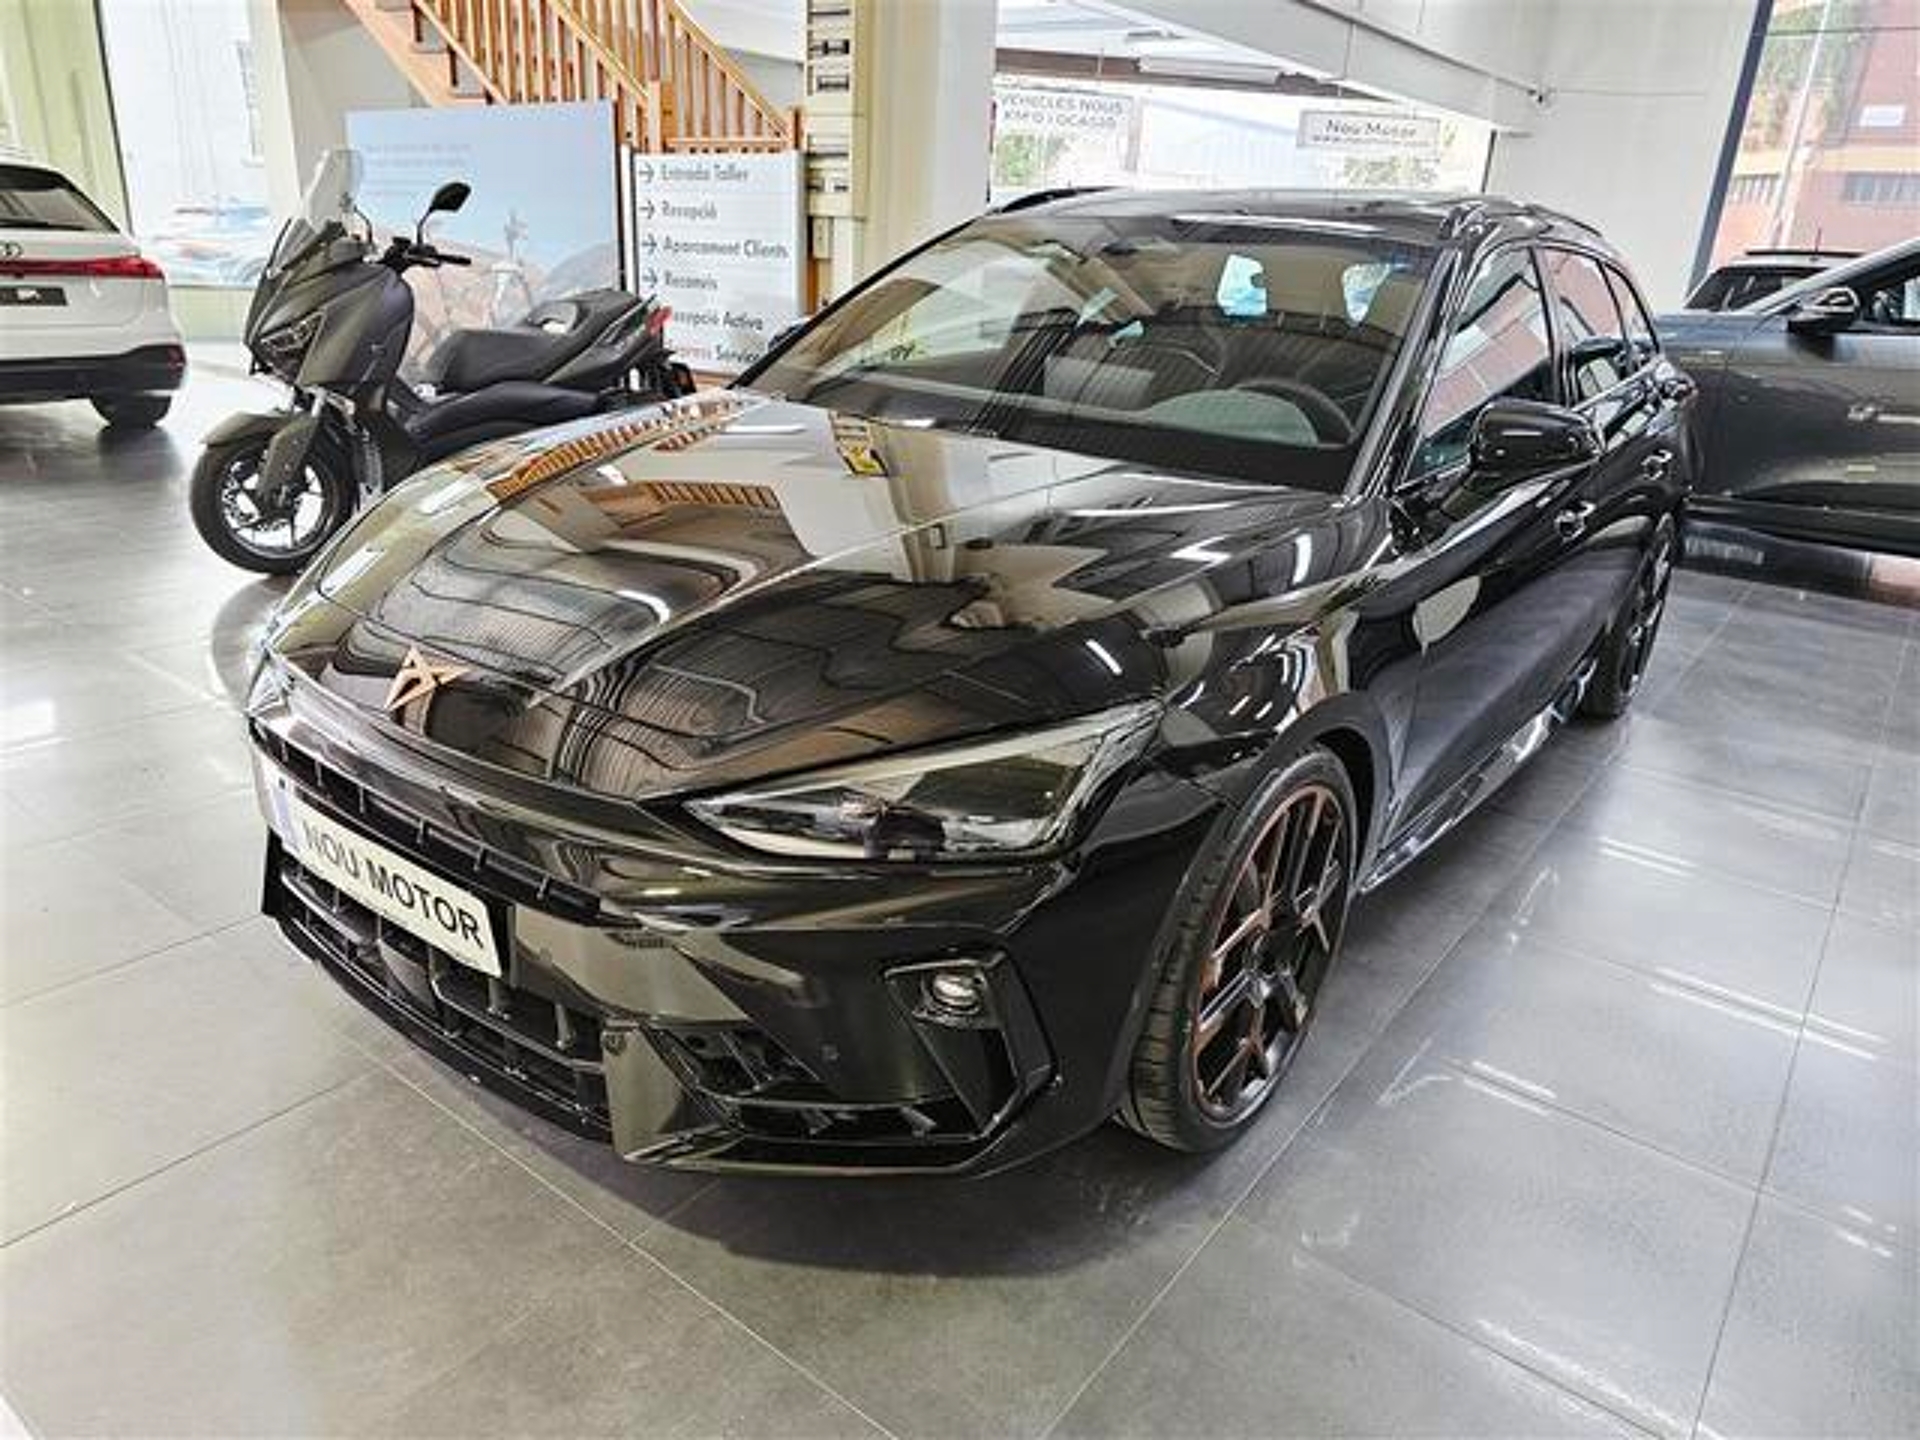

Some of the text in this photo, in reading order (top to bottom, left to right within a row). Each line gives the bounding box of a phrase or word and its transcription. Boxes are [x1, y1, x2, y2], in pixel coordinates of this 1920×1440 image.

[661, 163, 748, 182] Entrada Taller
[744, 239, 789, 258] Clients
[674, 308, 721, 328] ecepció
[303, 818, 484, 949] NOU MOTOR
